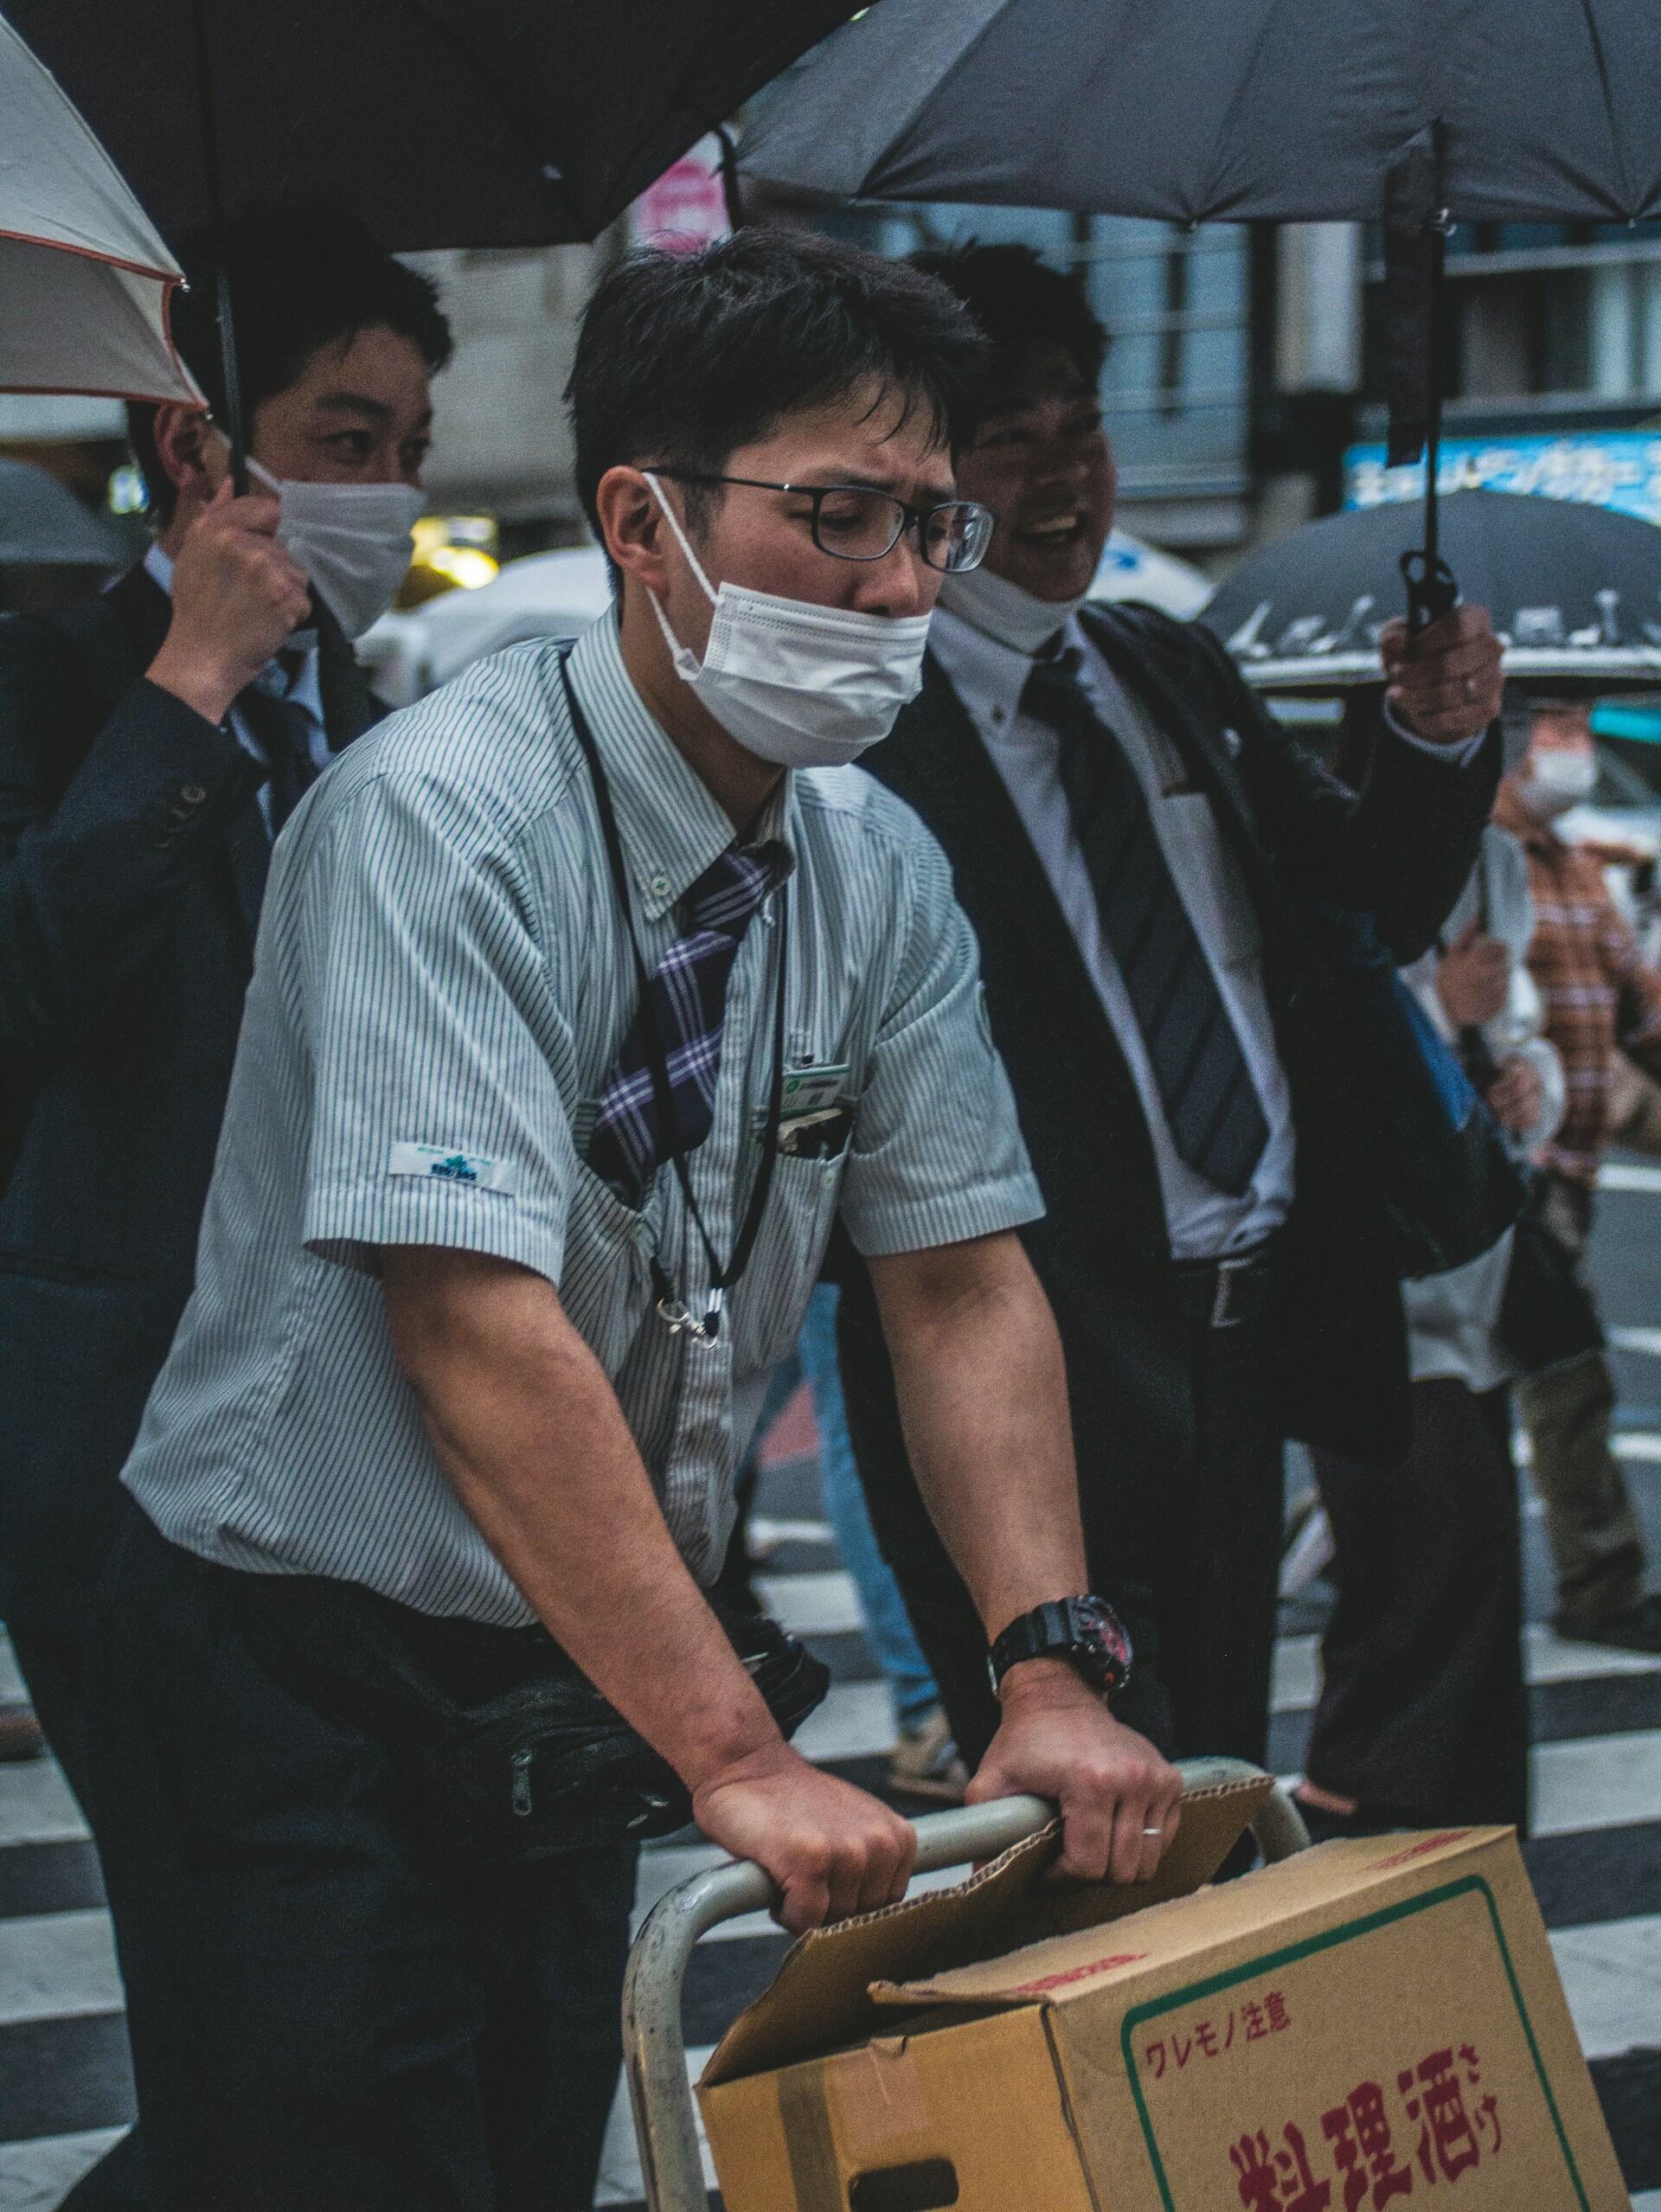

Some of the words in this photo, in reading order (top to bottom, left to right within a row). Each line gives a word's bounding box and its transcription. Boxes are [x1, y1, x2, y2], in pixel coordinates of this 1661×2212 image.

[1145, 1991, 1291, 2079] ワレモノ注意
[1229, 2047, 1480, 2212] 料理酒
